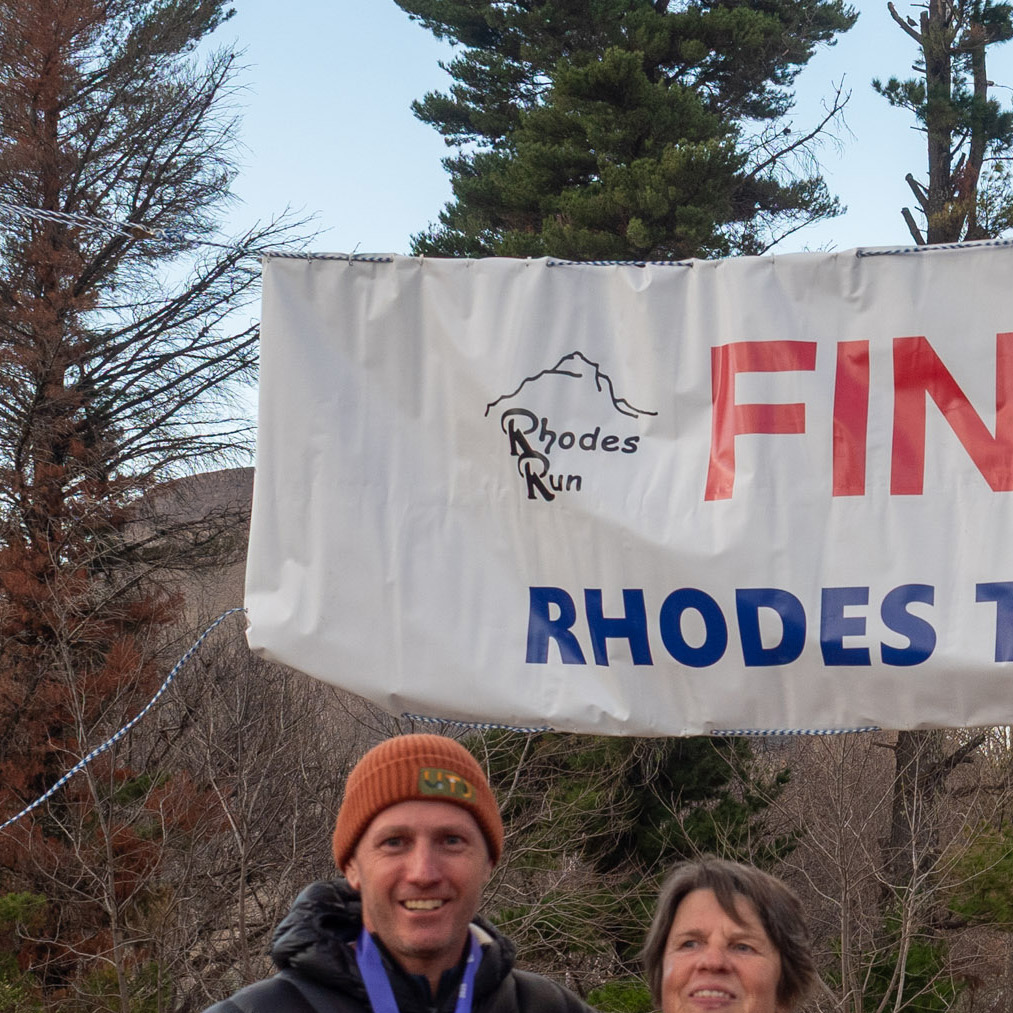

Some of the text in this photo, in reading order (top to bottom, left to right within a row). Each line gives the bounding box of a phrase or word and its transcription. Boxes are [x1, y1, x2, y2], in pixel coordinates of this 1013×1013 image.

[501, 408, 640, 457] Rhodes
[518, 450, 582, 501] Run
[525, 583, 937, 668] RHODES
